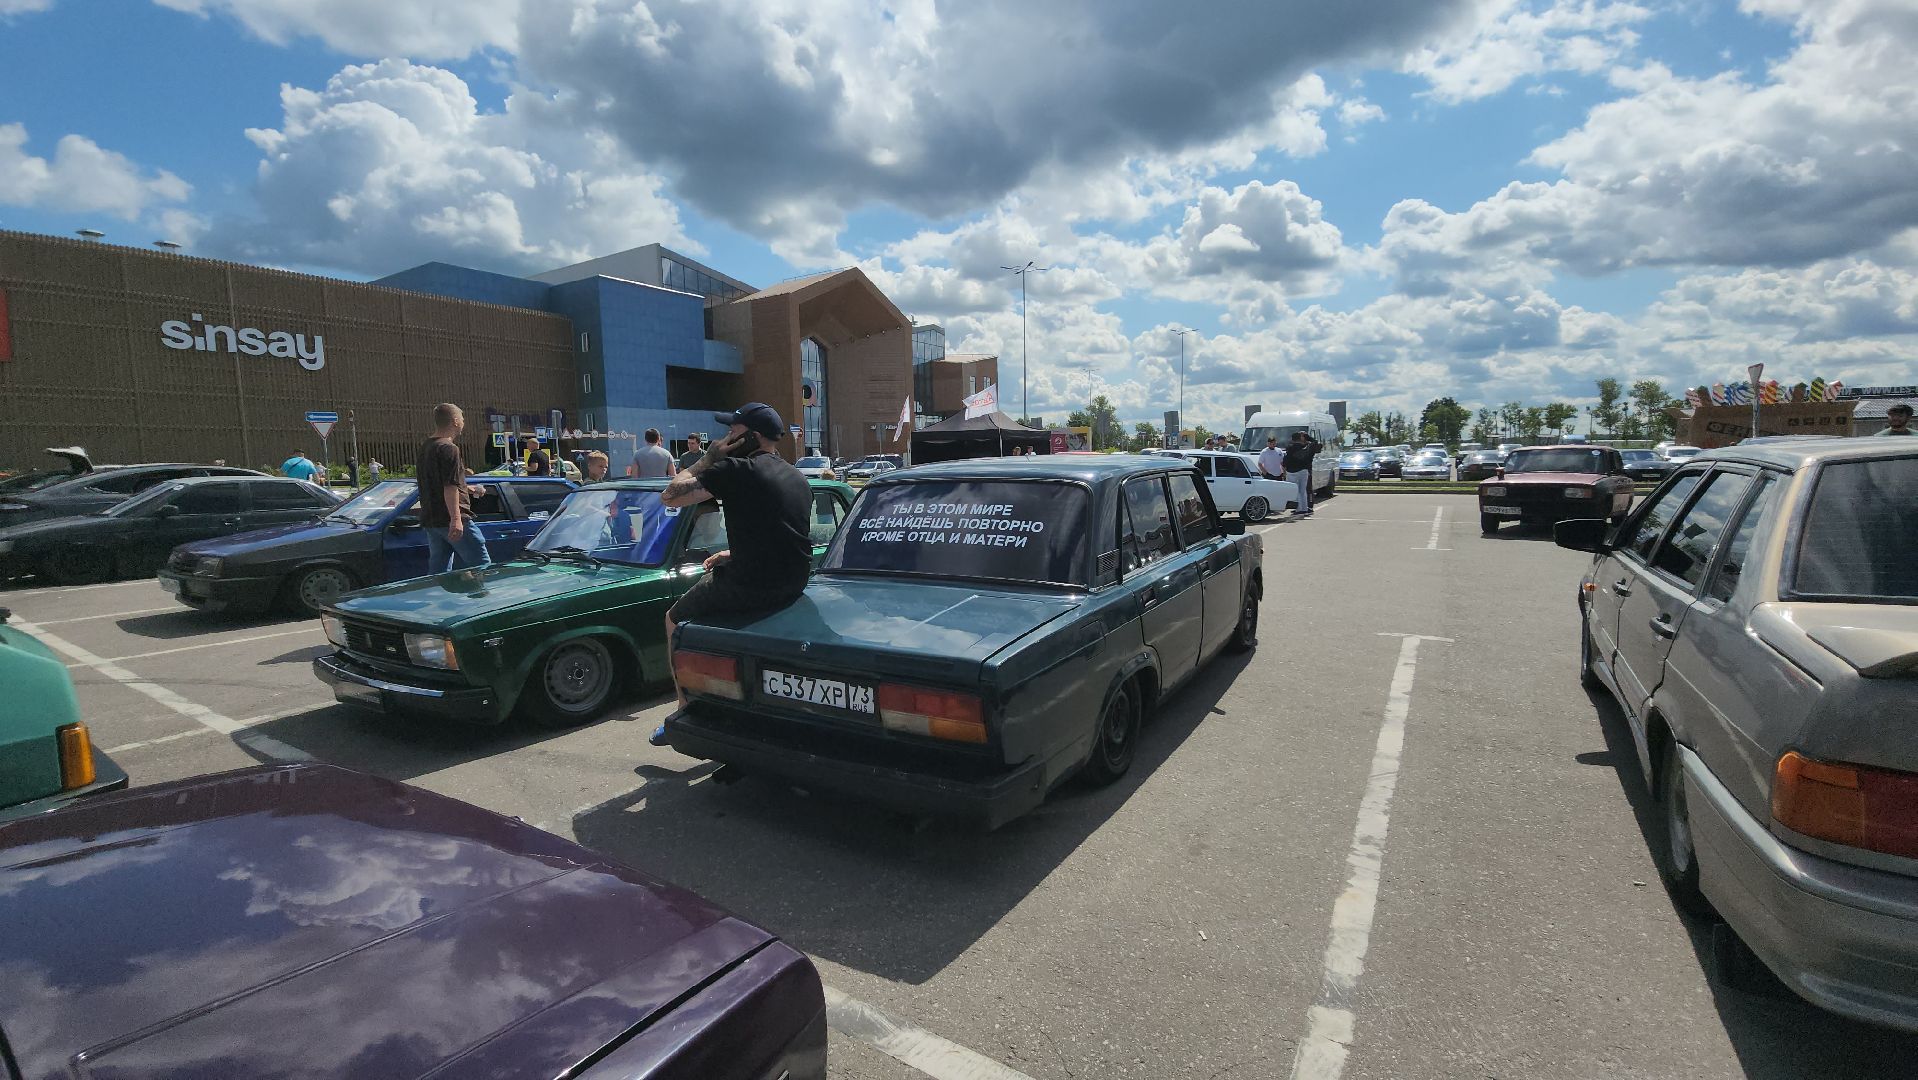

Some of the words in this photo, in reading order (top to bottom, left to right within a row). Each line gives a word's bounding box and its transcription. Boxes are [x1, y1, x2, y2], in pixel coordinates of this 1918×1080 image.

[160, 312, 325, 371] sinsay
[892, 503, 913, 515] ТЫ
[914, 503, 924, 514] В
[927, 503, 968, 515] ЭТОМ
[969, 504, 1014, 516] МИРЕ
[859, 515, 885, 529] ВСЁ
[885, 515, 954, 530] НАЙДЁШЬ
[958, 518, 1045, 533] ПОВТОРНО
[860, 531, 905, 542] КРОМЕ
[907, 531, 945, 545] ОТЦА
[948, 532, 960, 544] И
[962, 534, 1028, 548] МАТЕРИ
[853, 704, 868, 713] RUS
